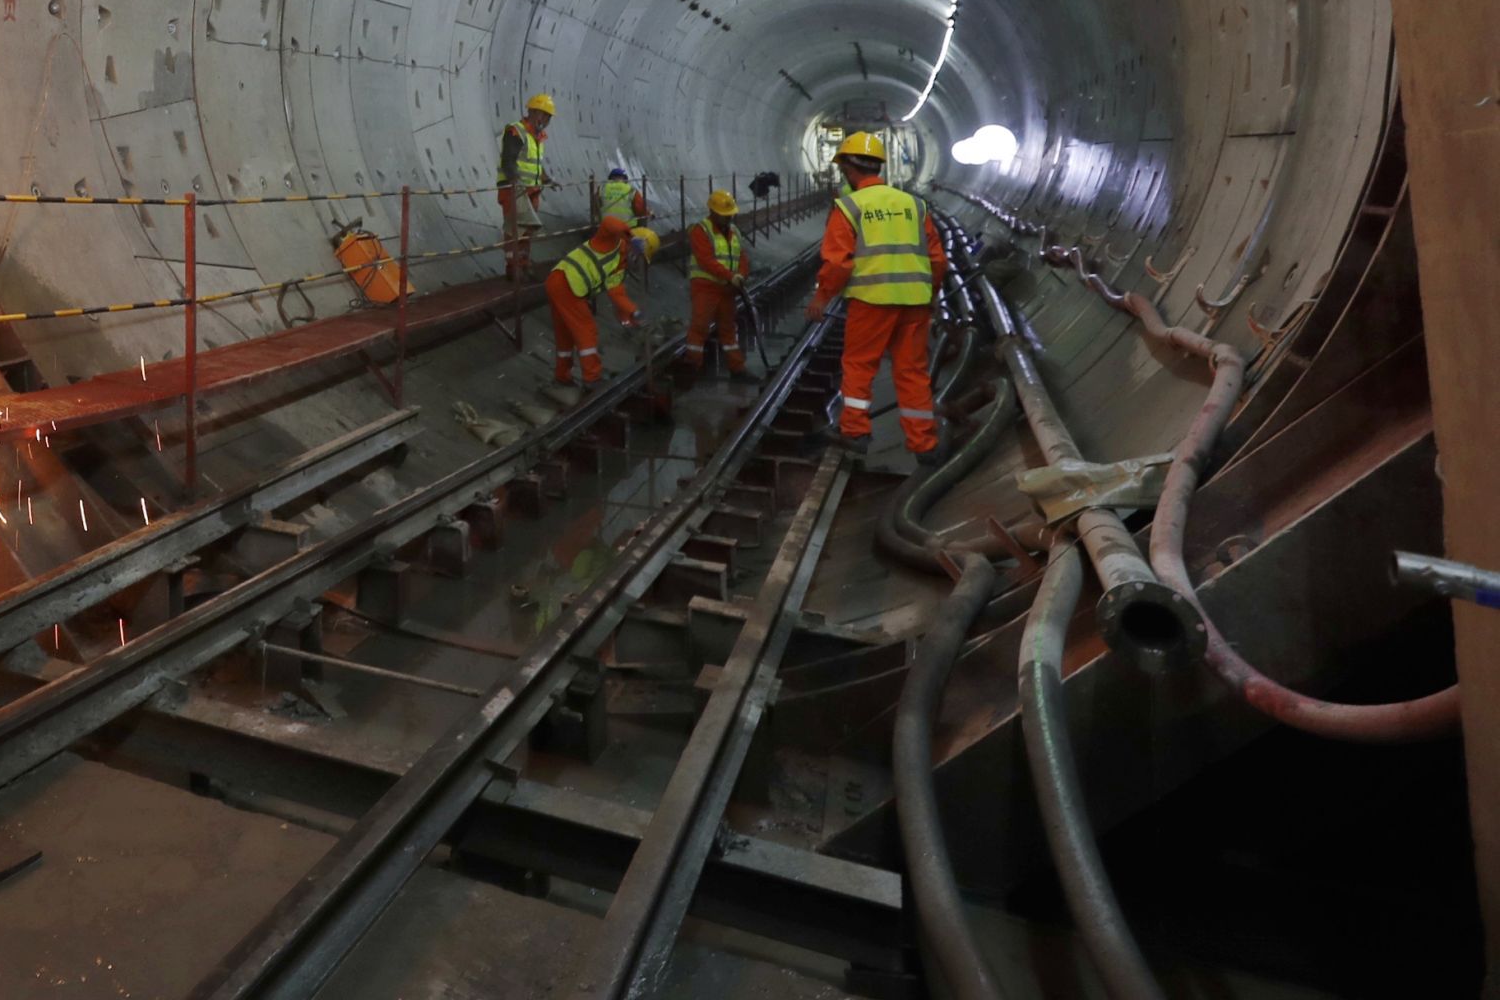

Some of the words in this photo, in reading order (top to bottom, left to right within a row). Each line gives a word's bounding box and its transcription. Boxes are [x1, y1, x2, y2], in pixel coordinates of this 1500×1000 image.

[864, 208, 913, 223] 中铁十一局
